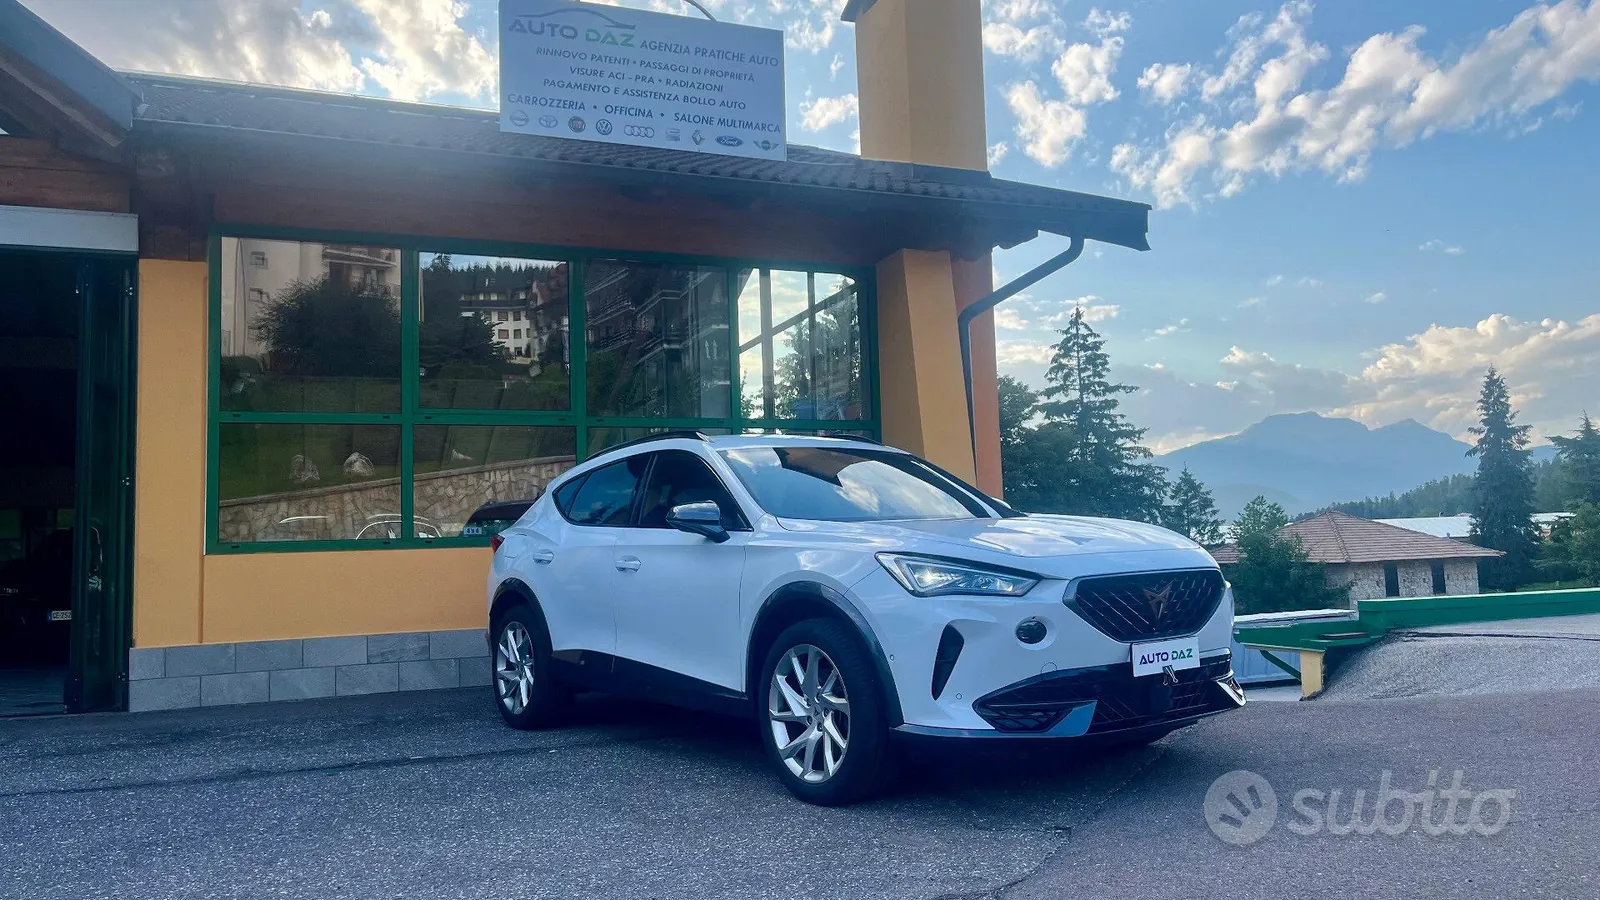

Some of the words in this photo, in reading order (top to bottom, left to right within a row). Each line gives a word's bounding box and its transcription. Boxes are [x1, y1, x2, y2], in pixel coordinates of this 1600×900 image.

[508, 18, 578, 40] AUTO
[585, 28, 635, 48] DAZ
[536, 46, 588, 60] RINNOVO
[591, 53, 630, 66] PATENTI
[640, 60, 689, 73] PASSAGGI
[692, 67, 701, 75] DI
[704, 68, 755, 82] PROPRIETÀ
[640, 40, 691, 55] AGENZIA
[694, 46, 746, 63] PRATICHE
[748, 54, 779, 67] AUTO
[543, 78, 610, 94] PAGAMENTO
[614, 87, 620, 95] E
[622, 88, 680, 102] ASSISTENZA
[683, 95, 716, 106] BOLLO
[719, 100, 747, 110] AUTO
[569, 66, 605, 78] VISURE
[608, 71, 625, 80] ACI
[635, 74, 655, 84] PRA
[665, 78, 724, 93] RADIAZIONI
[508, 93, 586, 111] CARROZZERIA
[604, 104, 653, 119] OFFICINA
[674, 112, 714, 126] SALONE
[717, 117, 781, 134] MULTIMARCA
[1139, 652, 1169, 665] AUTO
[1171, 648, 1193, 660] DAZ
